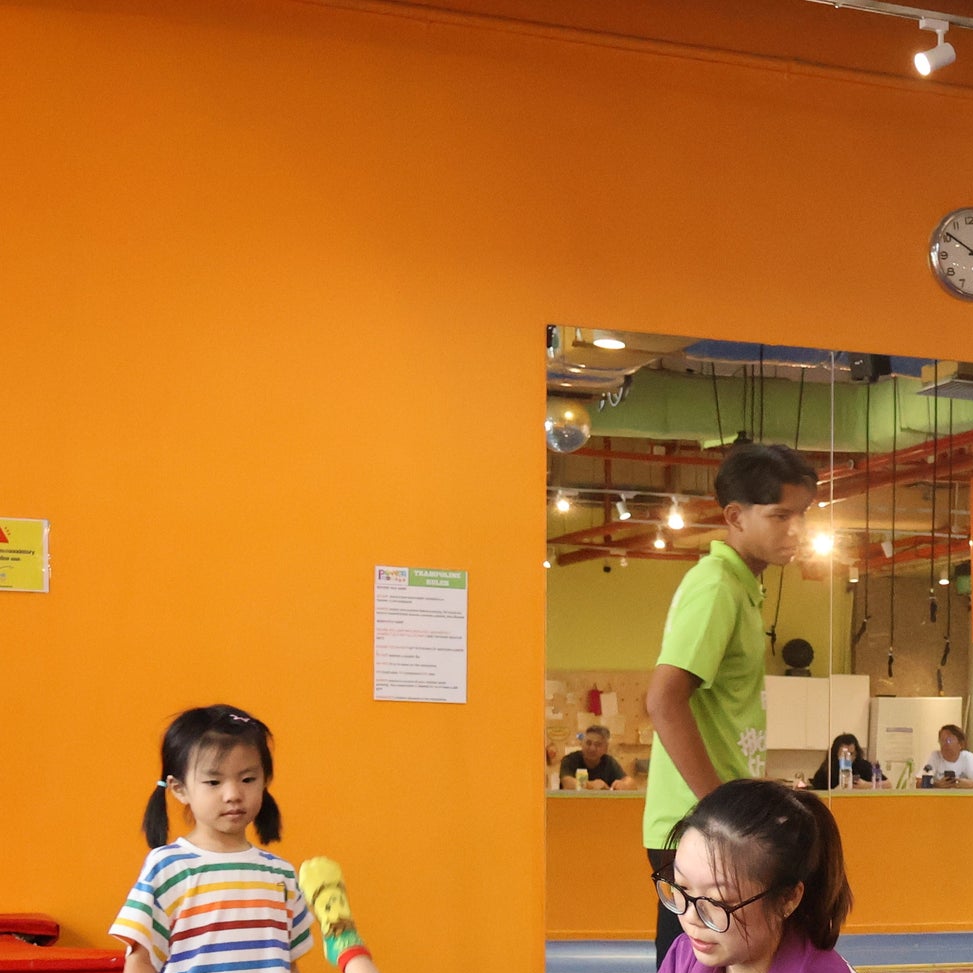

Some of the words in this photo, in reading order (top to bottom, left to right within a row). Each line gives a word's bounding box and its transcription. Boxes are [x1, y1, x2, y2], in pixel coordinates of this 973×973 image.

[953, 221, 959, 231] 11
[940, 251, 949, 260] 9
[946, 267, 956, 276] 8
[958, 278, 966, 288] 7
